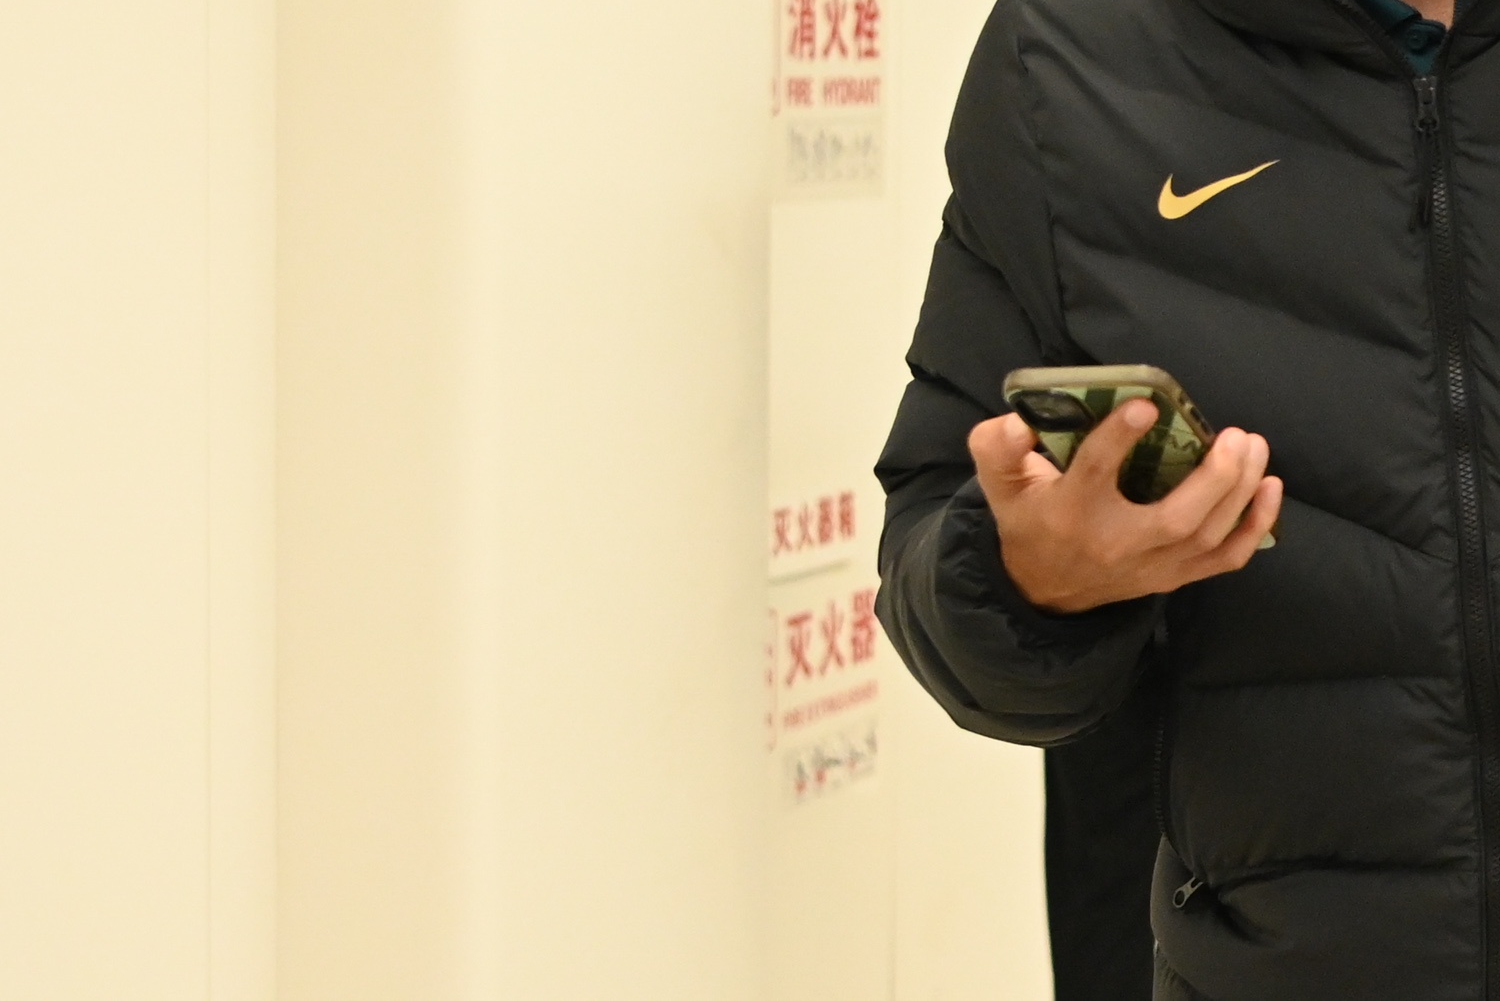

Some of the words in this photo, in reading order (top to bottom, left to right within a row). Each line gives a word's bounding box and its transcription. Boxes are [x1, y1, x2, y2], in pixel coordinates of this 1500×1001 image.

[787, 77, 813, 106] FIRE
[823, 77, 880, 106] HYDRANT
[786, 590, 875, 687] 灭火器
